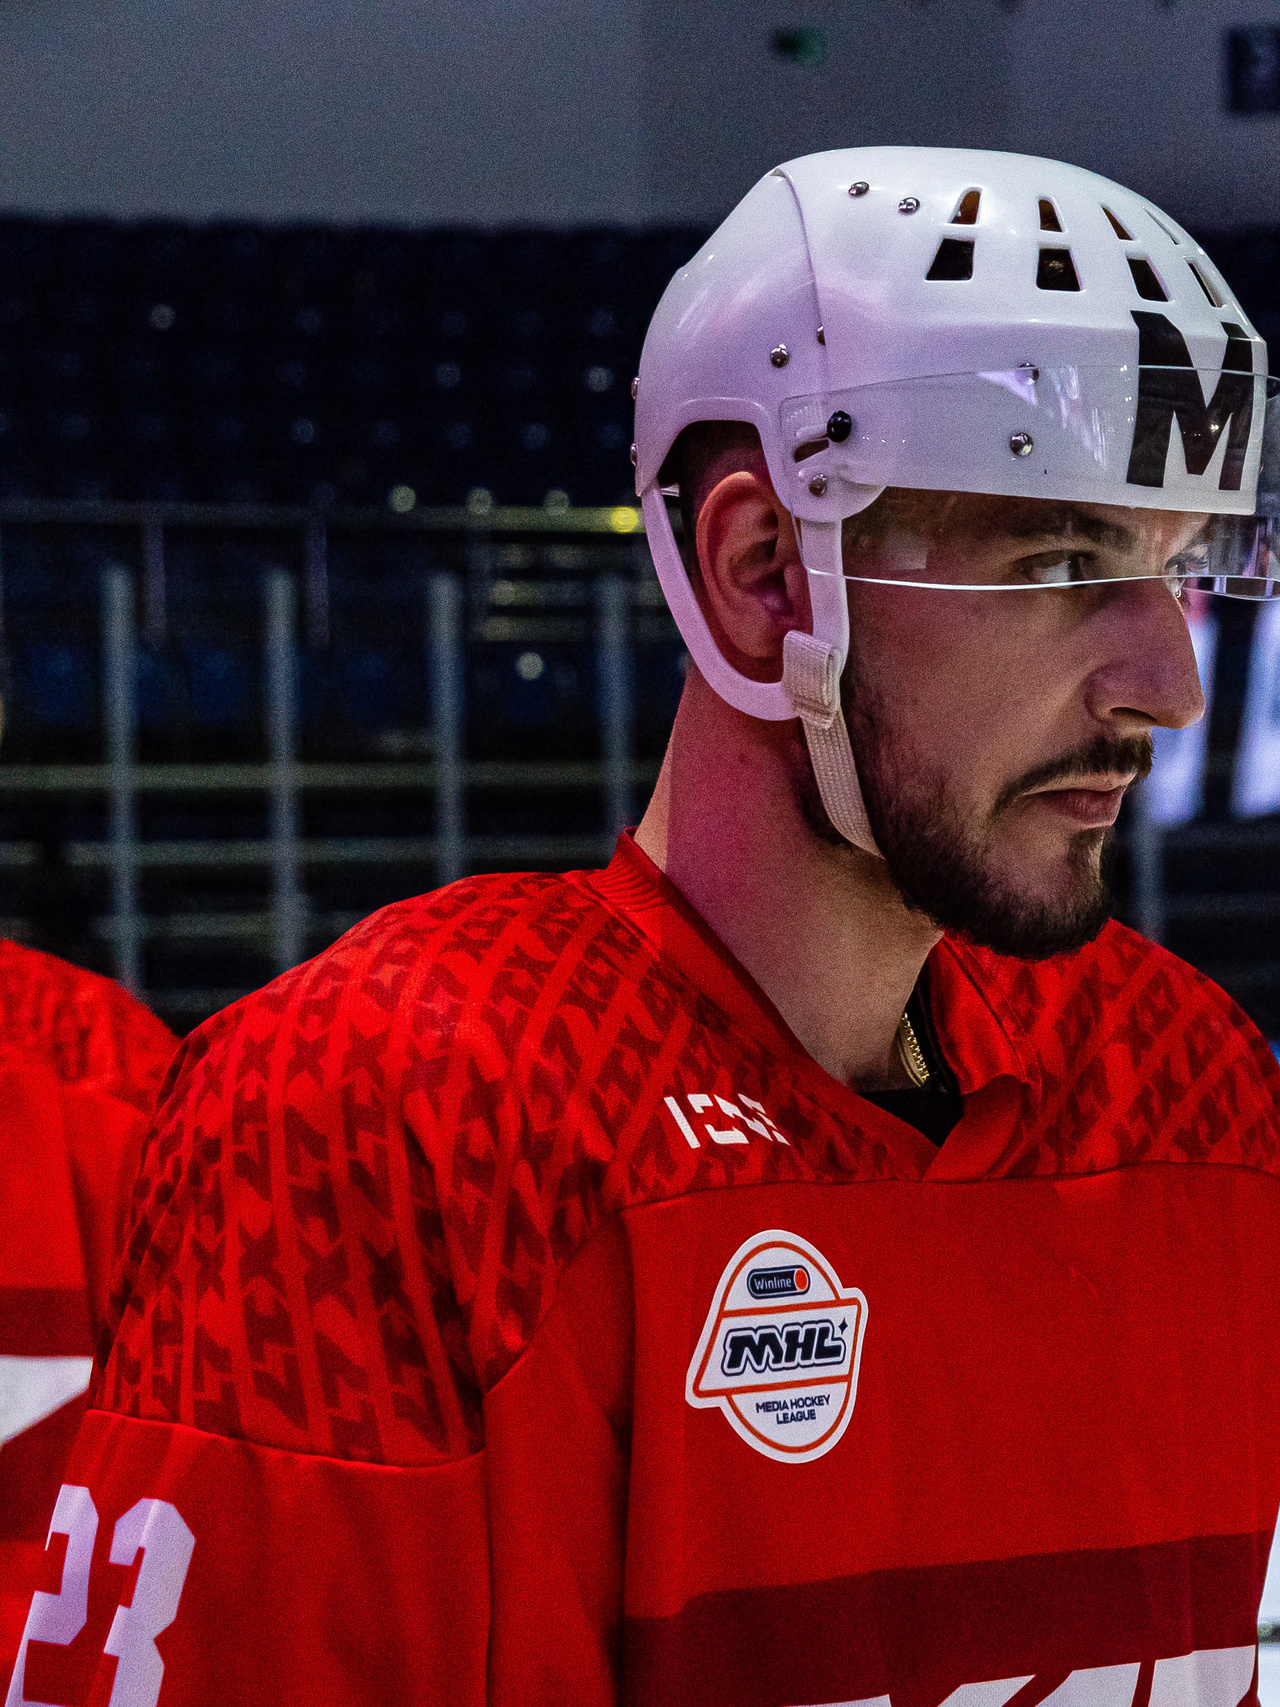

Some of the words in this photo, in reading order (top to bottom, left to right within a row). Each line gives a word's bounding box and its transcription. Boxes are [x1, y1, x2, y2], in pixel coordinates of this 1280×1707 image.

[1126, 309, 1255, 491] M
[753, 1275, 792, 1291] Winline
[724, 1324, 843, 1373] MHL
[755, 1400, 790, 1414] MEDIA
[790, 1394, 831, 1410] HOCKEY
[776, 1409, 817, 1425] LEAGUE
[5, 1484, 196, 1707] 23
